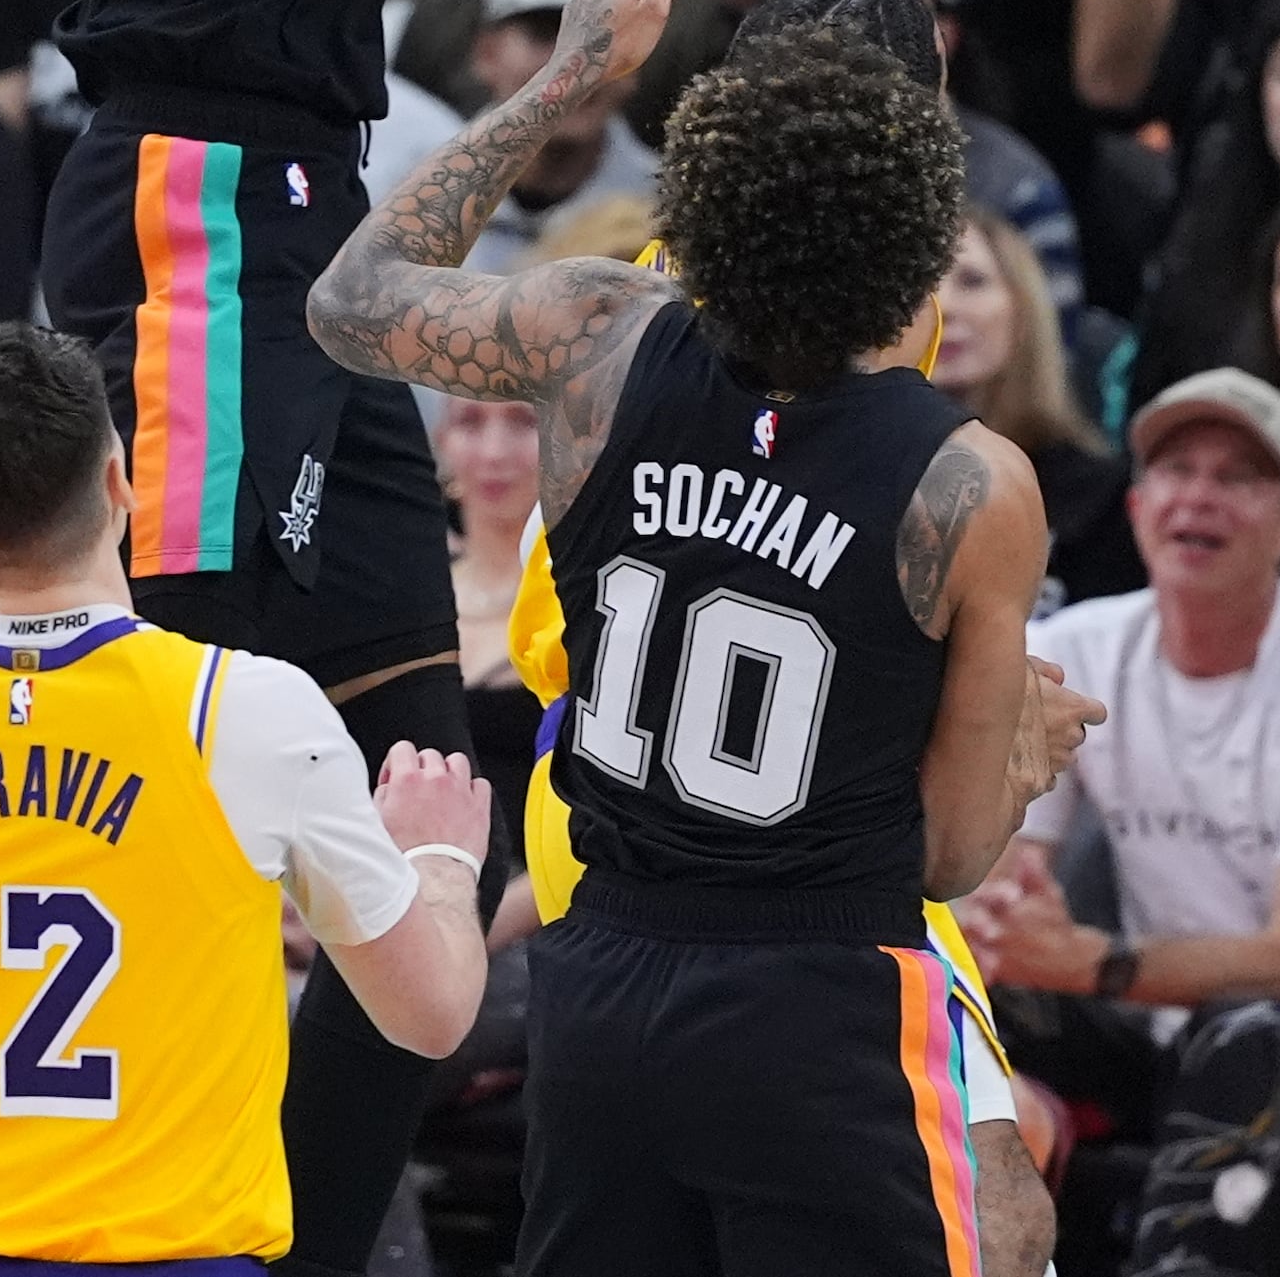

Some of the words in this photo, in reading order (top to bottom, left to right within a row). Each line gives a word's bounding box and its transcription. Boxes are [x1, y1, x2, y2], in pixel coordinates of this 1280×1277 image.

[632, 461, 857, 591] SOCHAN
[8, 619, 48, 635] NIKE
[53, 612, 89, 632] PRO
[572, 554, 838, 828] 10
